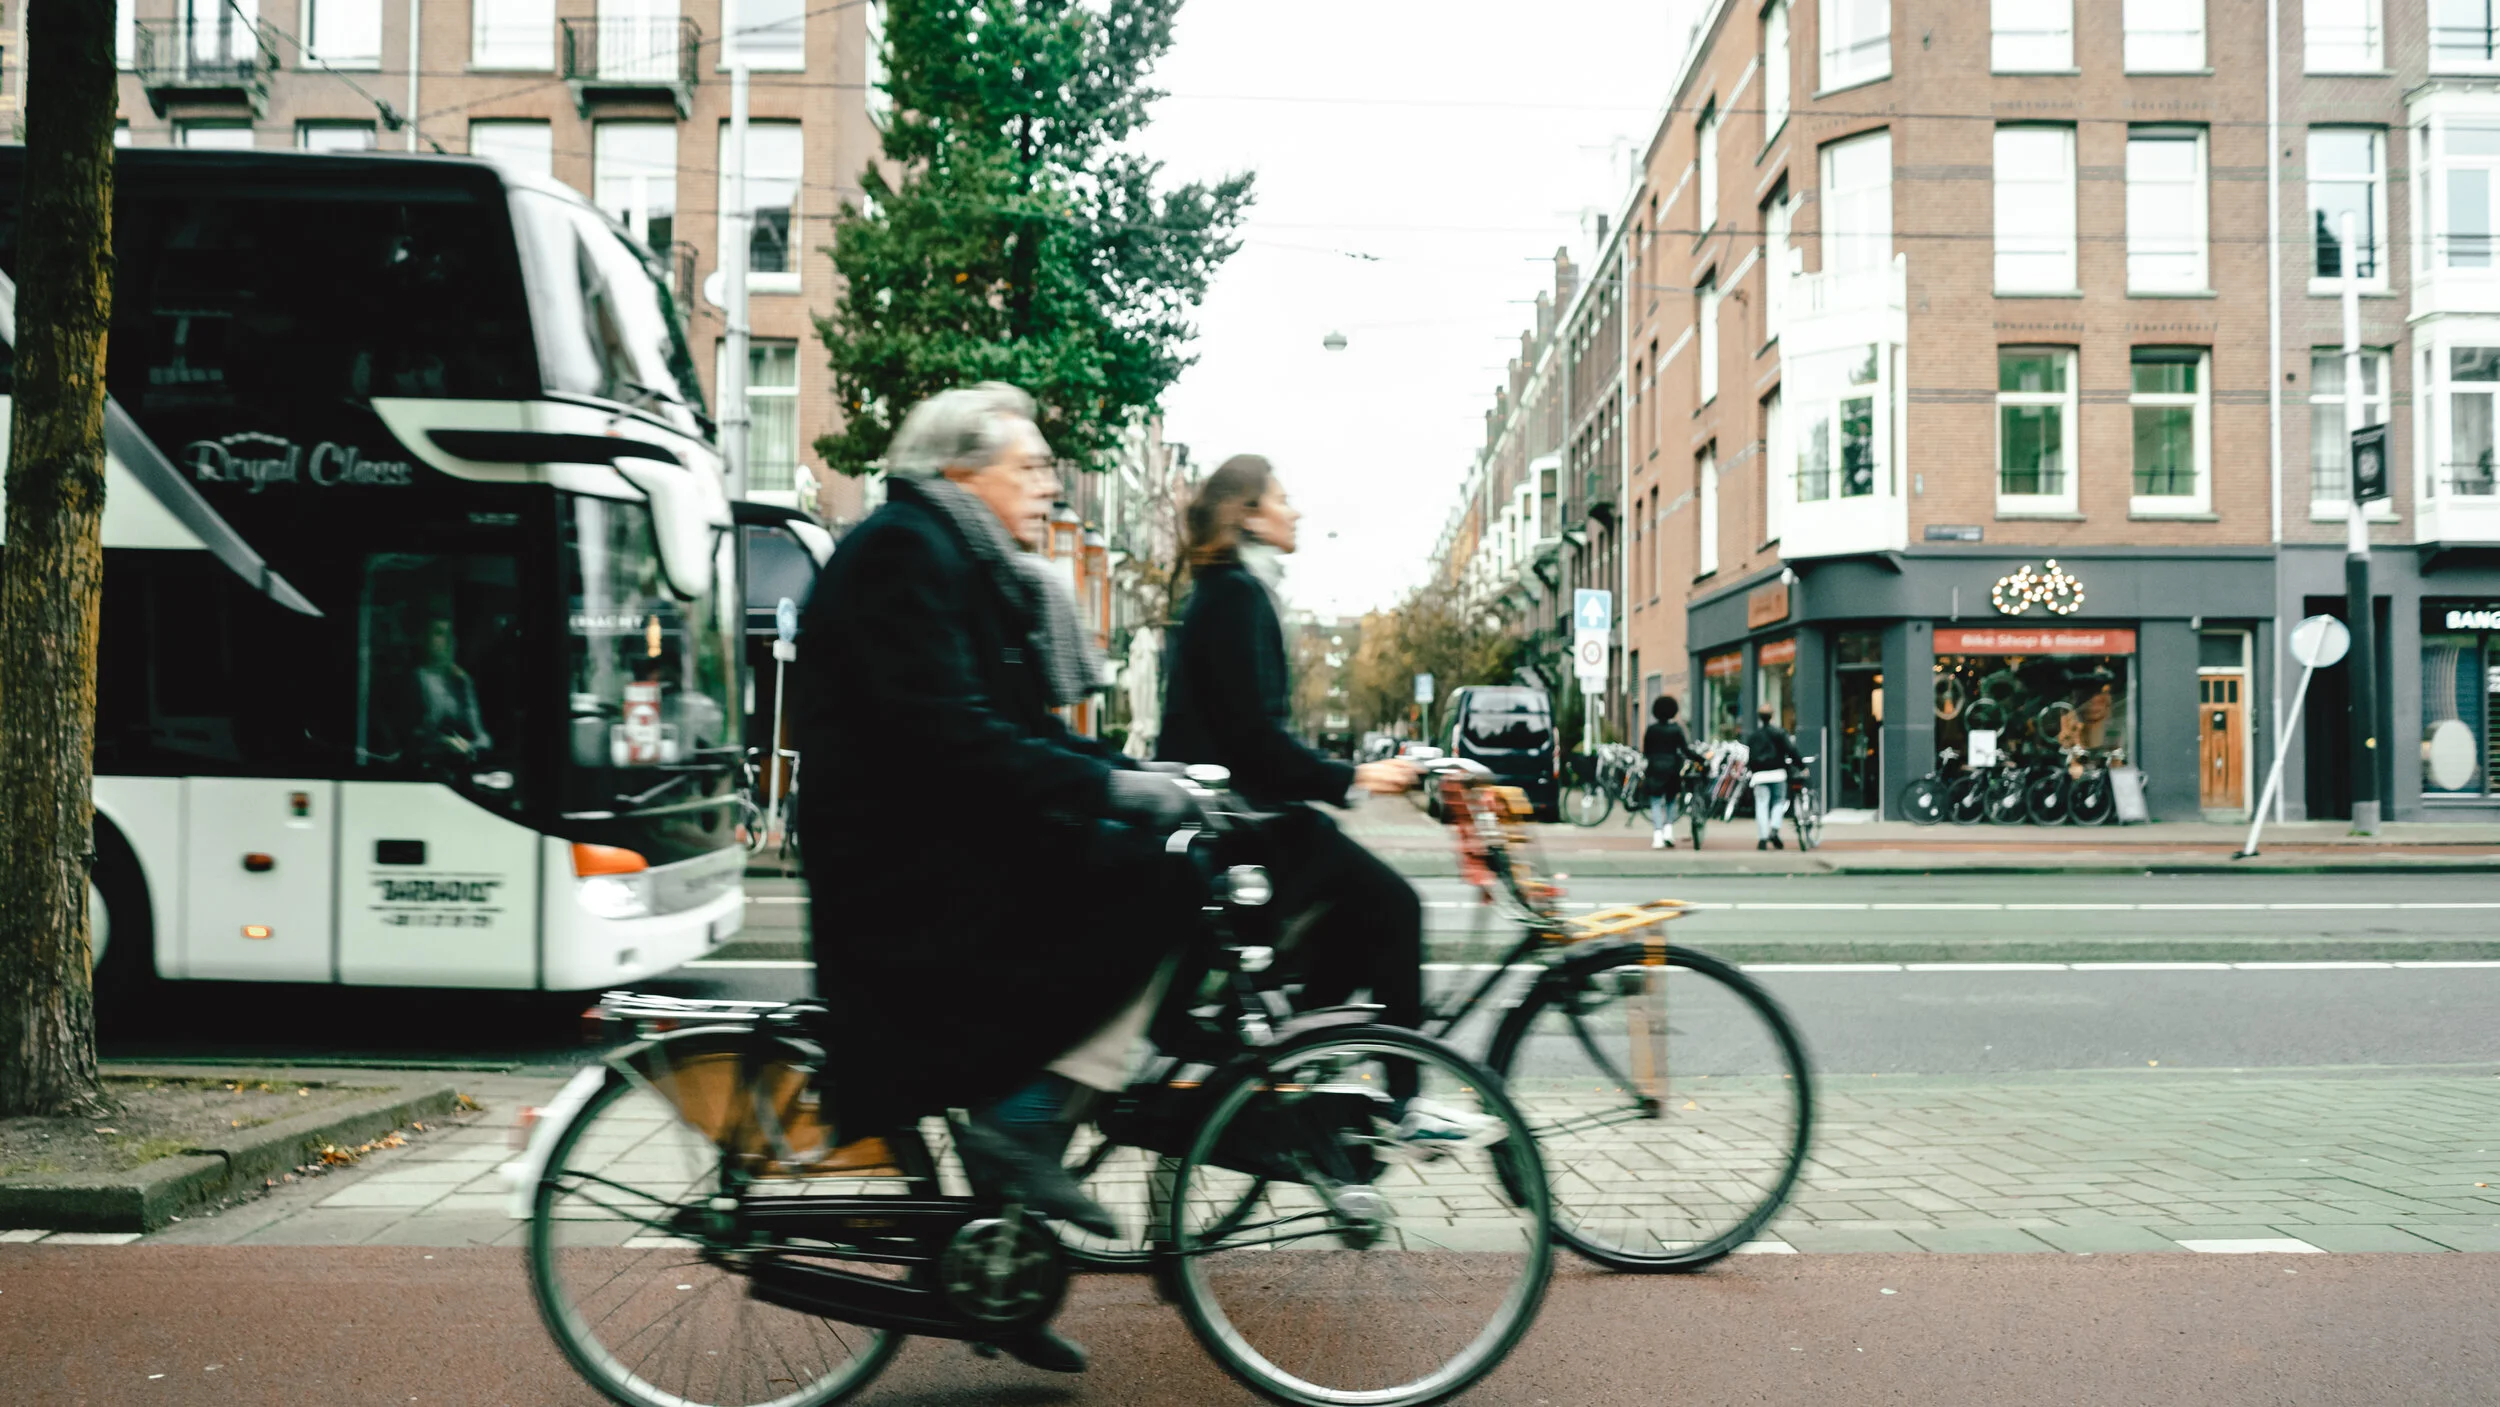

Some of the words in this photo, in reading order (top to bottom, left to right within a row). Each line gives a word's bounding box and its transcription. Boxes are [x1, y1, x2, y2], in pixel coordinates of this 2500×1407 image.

[308, 441, 413, 486] Class
[1961, 633, 1995, 648] Bike
[1998, 633, 2038, 648] Shop
[2040, 634, 2053, 648] &
